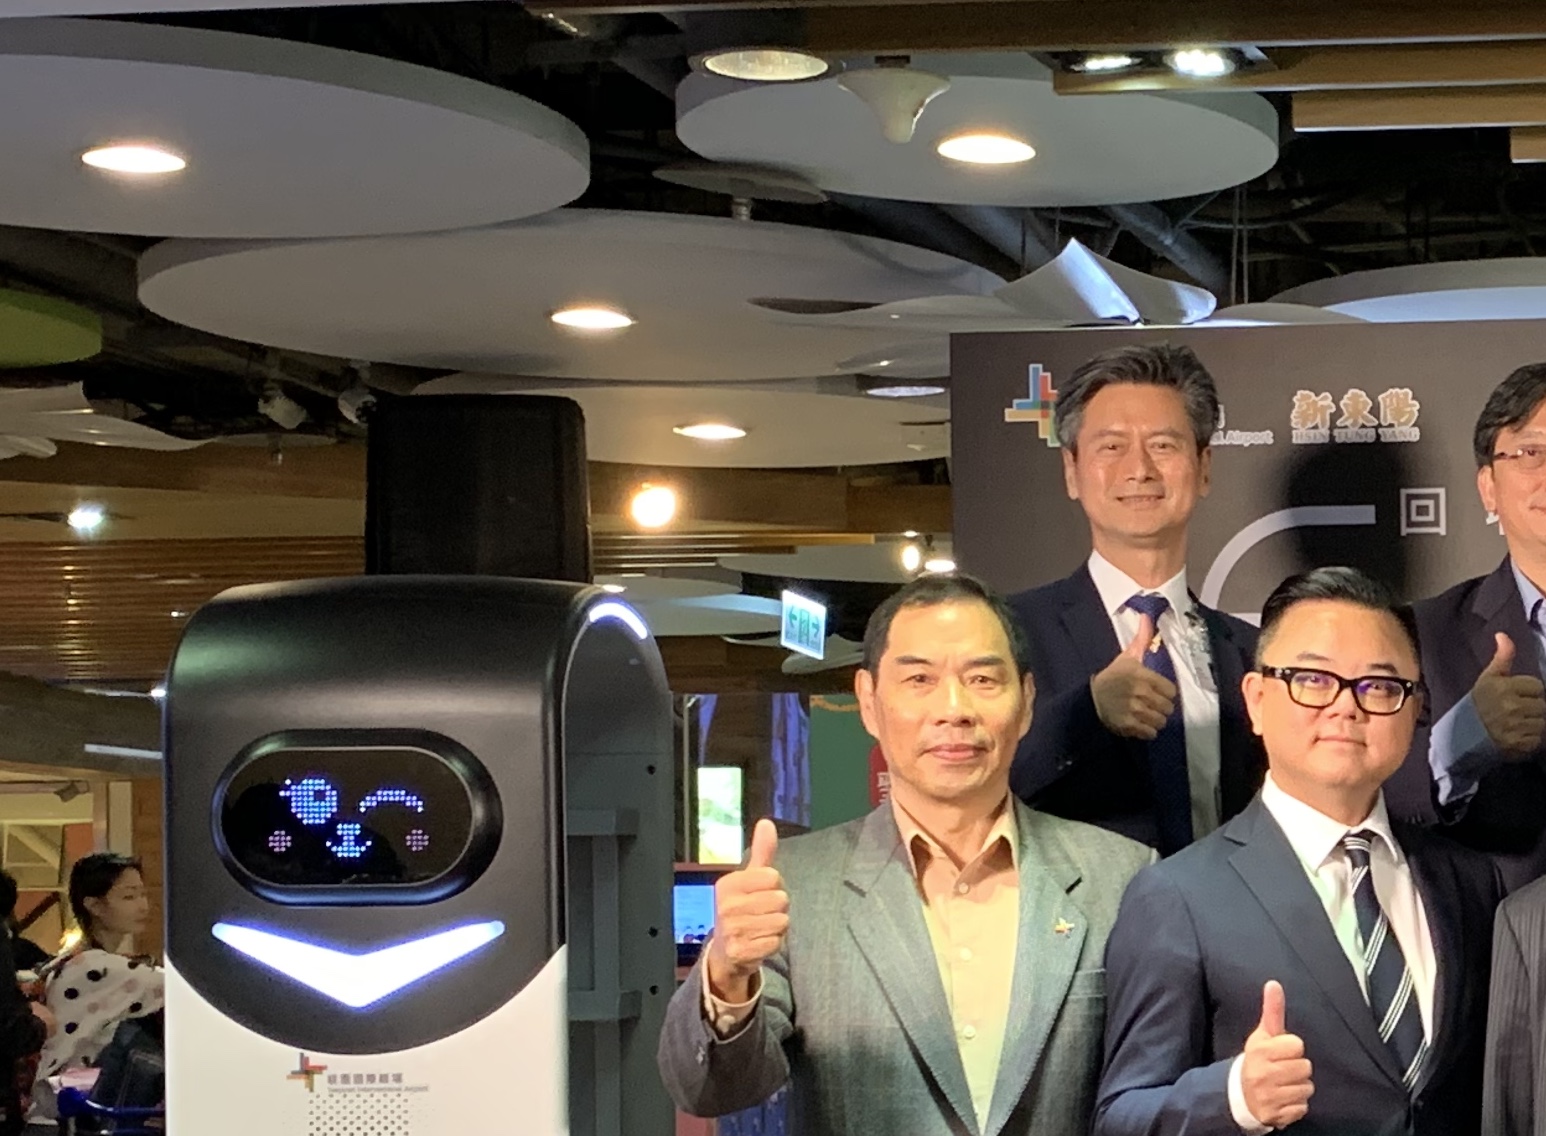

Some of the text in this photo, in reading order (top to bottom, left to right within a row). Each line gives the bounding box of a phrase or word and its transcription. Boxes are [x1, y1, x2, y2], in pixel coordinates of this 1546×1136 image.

[1291, 389, 1420, 429] 新東陽
[1292, 427, 1420, 443] HSIN TUNG YANG
